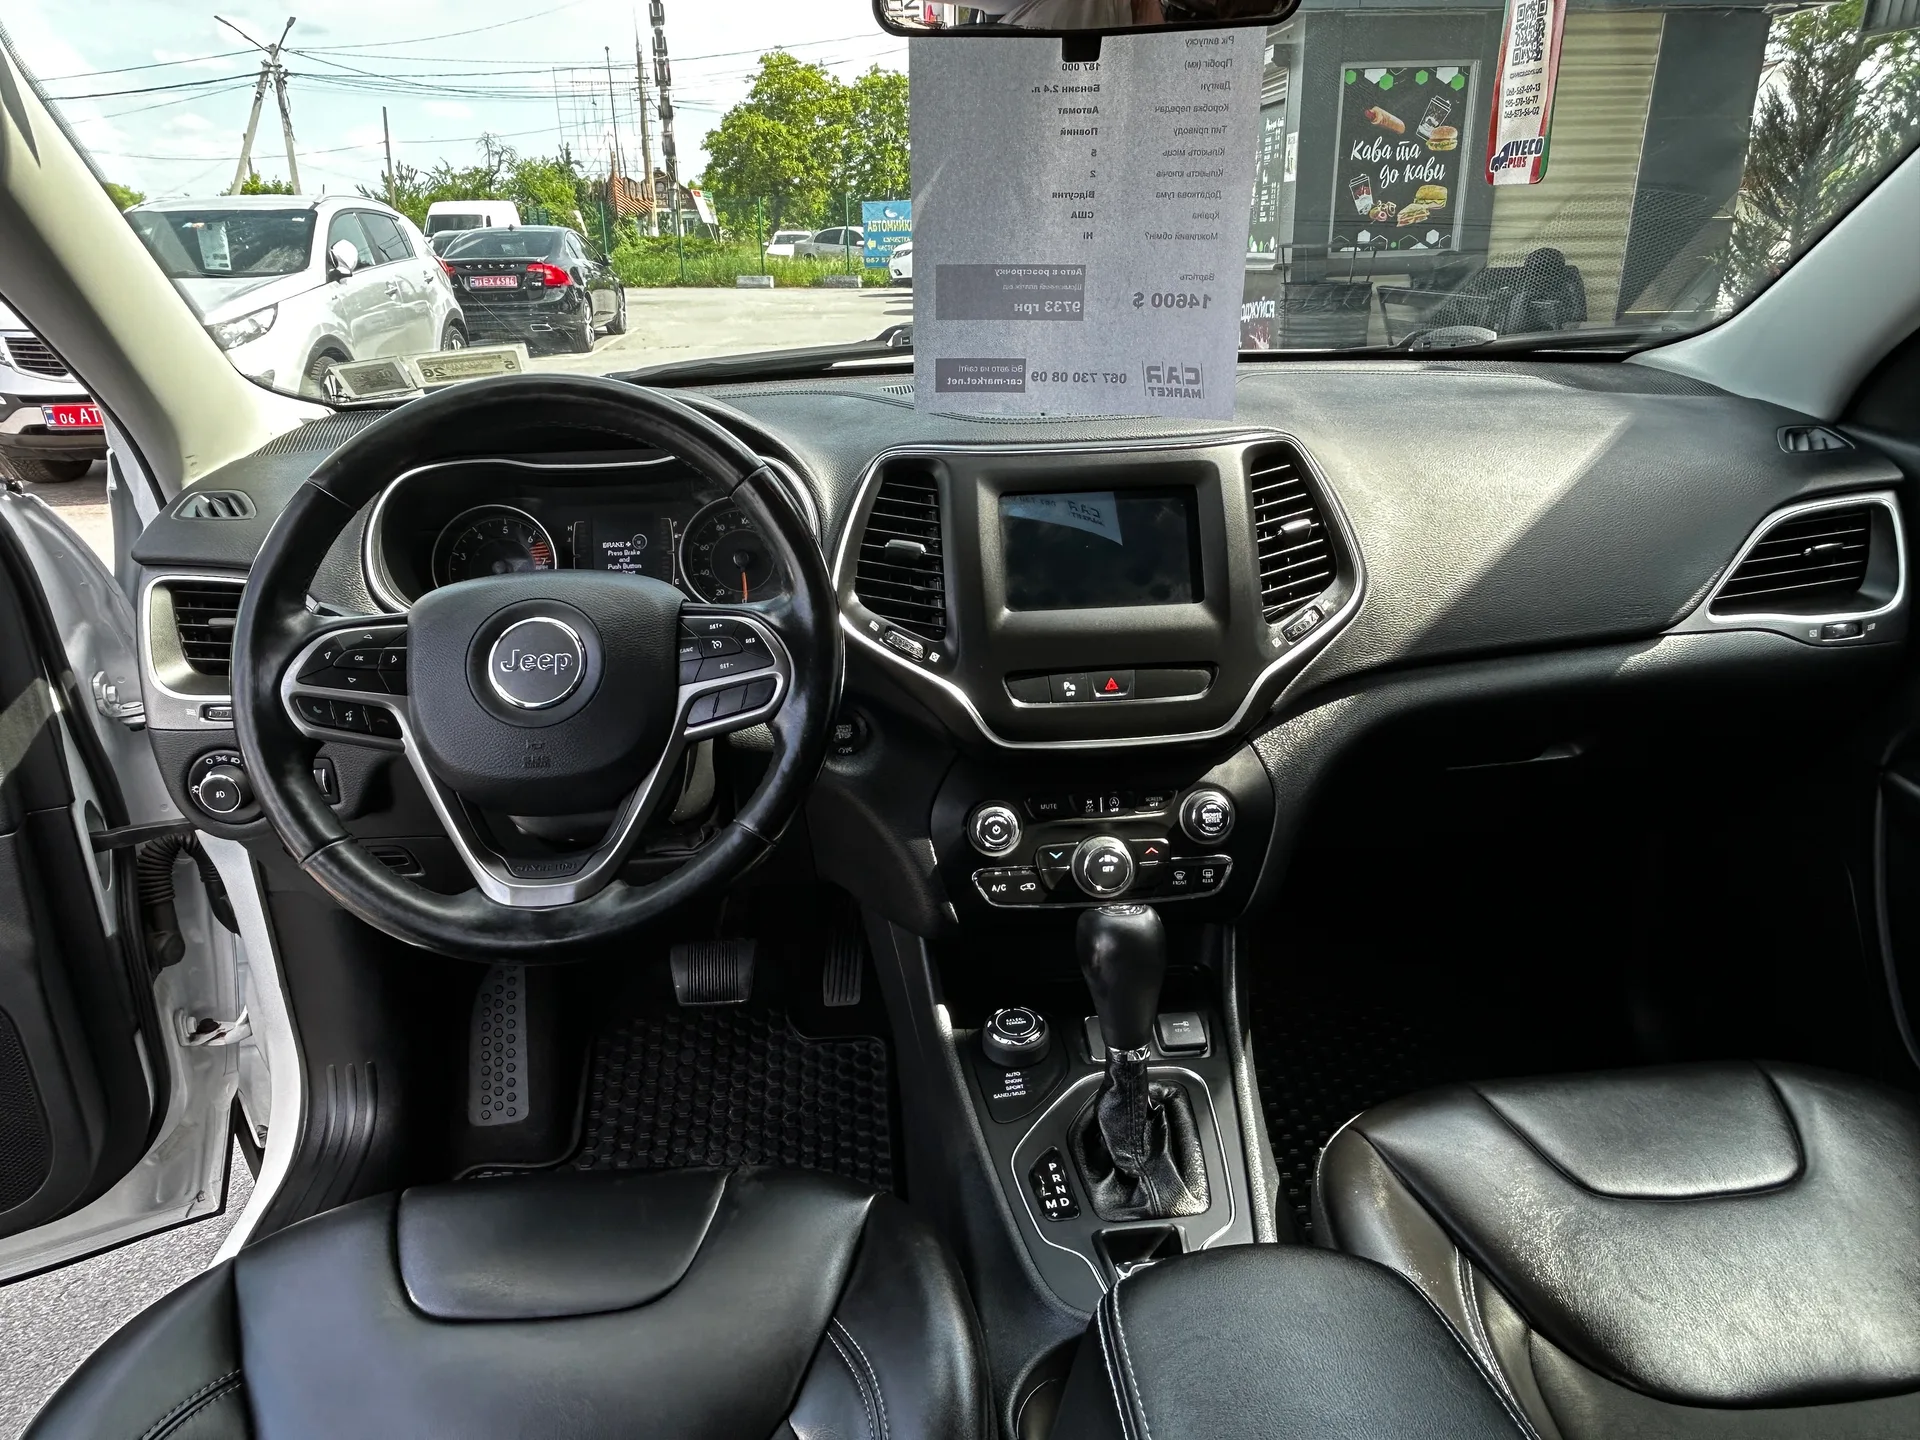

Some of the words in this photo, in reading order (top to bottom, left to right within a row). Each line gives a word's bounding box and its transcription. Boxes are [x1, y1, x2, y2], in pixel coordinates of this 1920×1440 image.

[1351, 136, 1393, 163] Кава
[1396, 141, 1421, 161] та
[1510, 138, 1544, 156] IVECO
[1508, 156, 1528, 169] PLUS
[1380, 164, 1400, 189] до
[1403, 156, 1446, 182] кави
[59, 413, 76, 424] 06
[80, 407, 101, 424] AT
[502, 526, 508, 534] 5
[715, 588, 725, 596] 20
[500, 649, 573, 675] Jeep
[991, 884, 1007, 892] A/C
[1048, 1162, 1057, 1171] P
[1051, 1174, 1062, 1183] R
[1055, 1184, 1066, 1194] N
[1045, 1199, 1057, 1209] M
[1060, 1198, 1070, 1207] D
